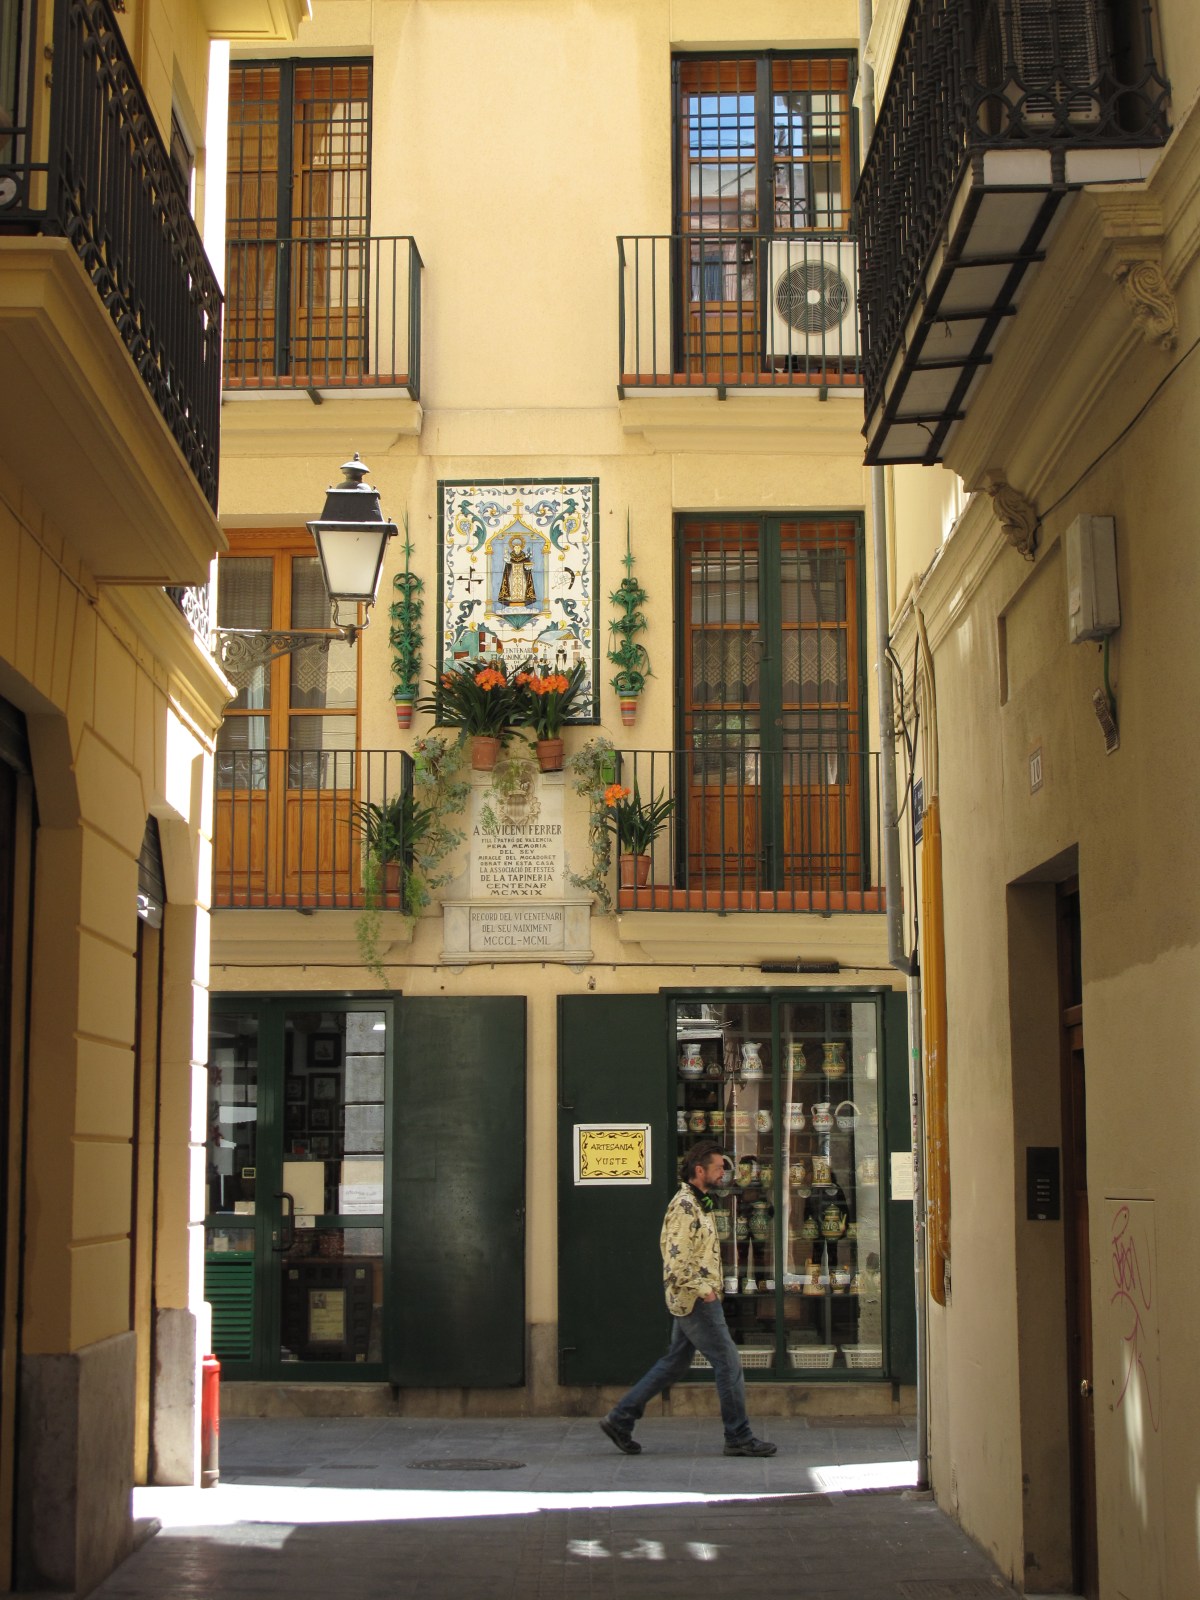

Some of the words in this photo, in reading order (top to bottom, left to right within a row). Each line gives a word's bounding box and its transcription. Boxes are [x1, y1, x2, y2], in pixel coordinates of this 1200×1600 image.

[1033, 758, 1041, 783] 10
[473, 825, 480, 835] A
[496, 825, 525, 835] VICENT
[529, 825, 562, 835] FERRER
[472, 913, 497, 921] RECORD
[513, 924, 552, 932] NAIXIMENT
[591, 1143, 634, 1151] ARTESANIA
